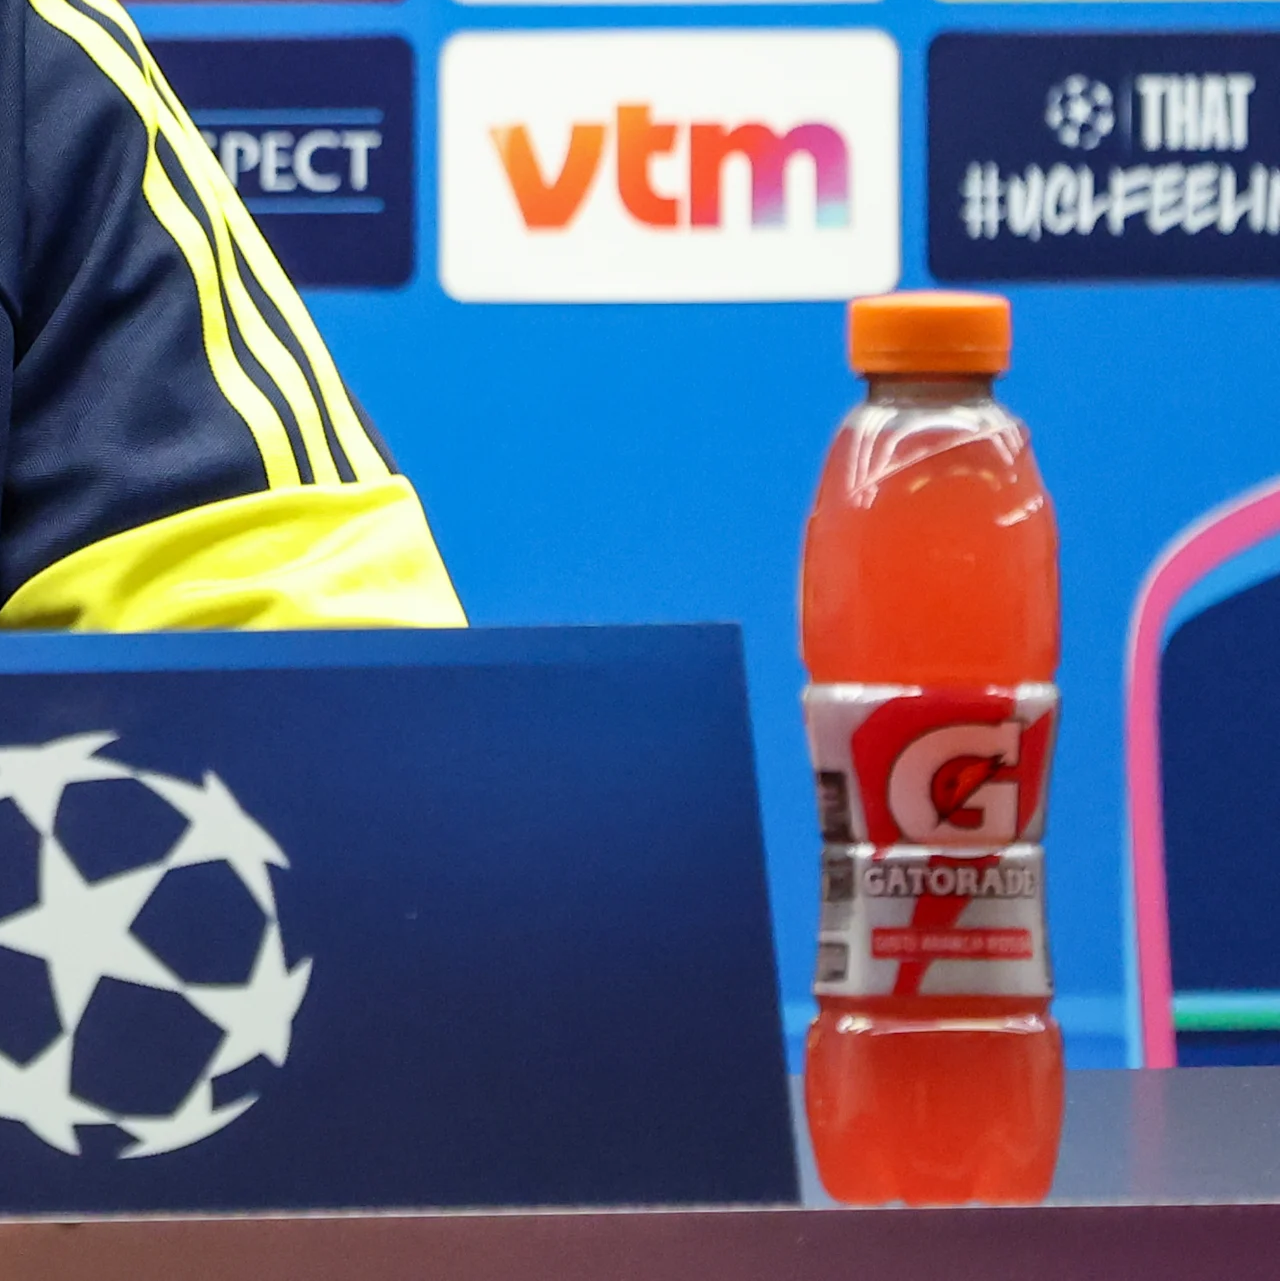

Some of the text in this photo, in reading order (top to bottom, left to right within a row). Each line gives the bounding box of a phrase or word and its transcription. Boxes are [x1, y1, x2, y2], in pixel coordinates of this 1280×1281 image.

[1136, 73, 1256, 152] THAT
[219, 129, 383, 193] PECT
[489, 102, 852, 233] vtm
[863, 865, 1038, 899] GATORADE
